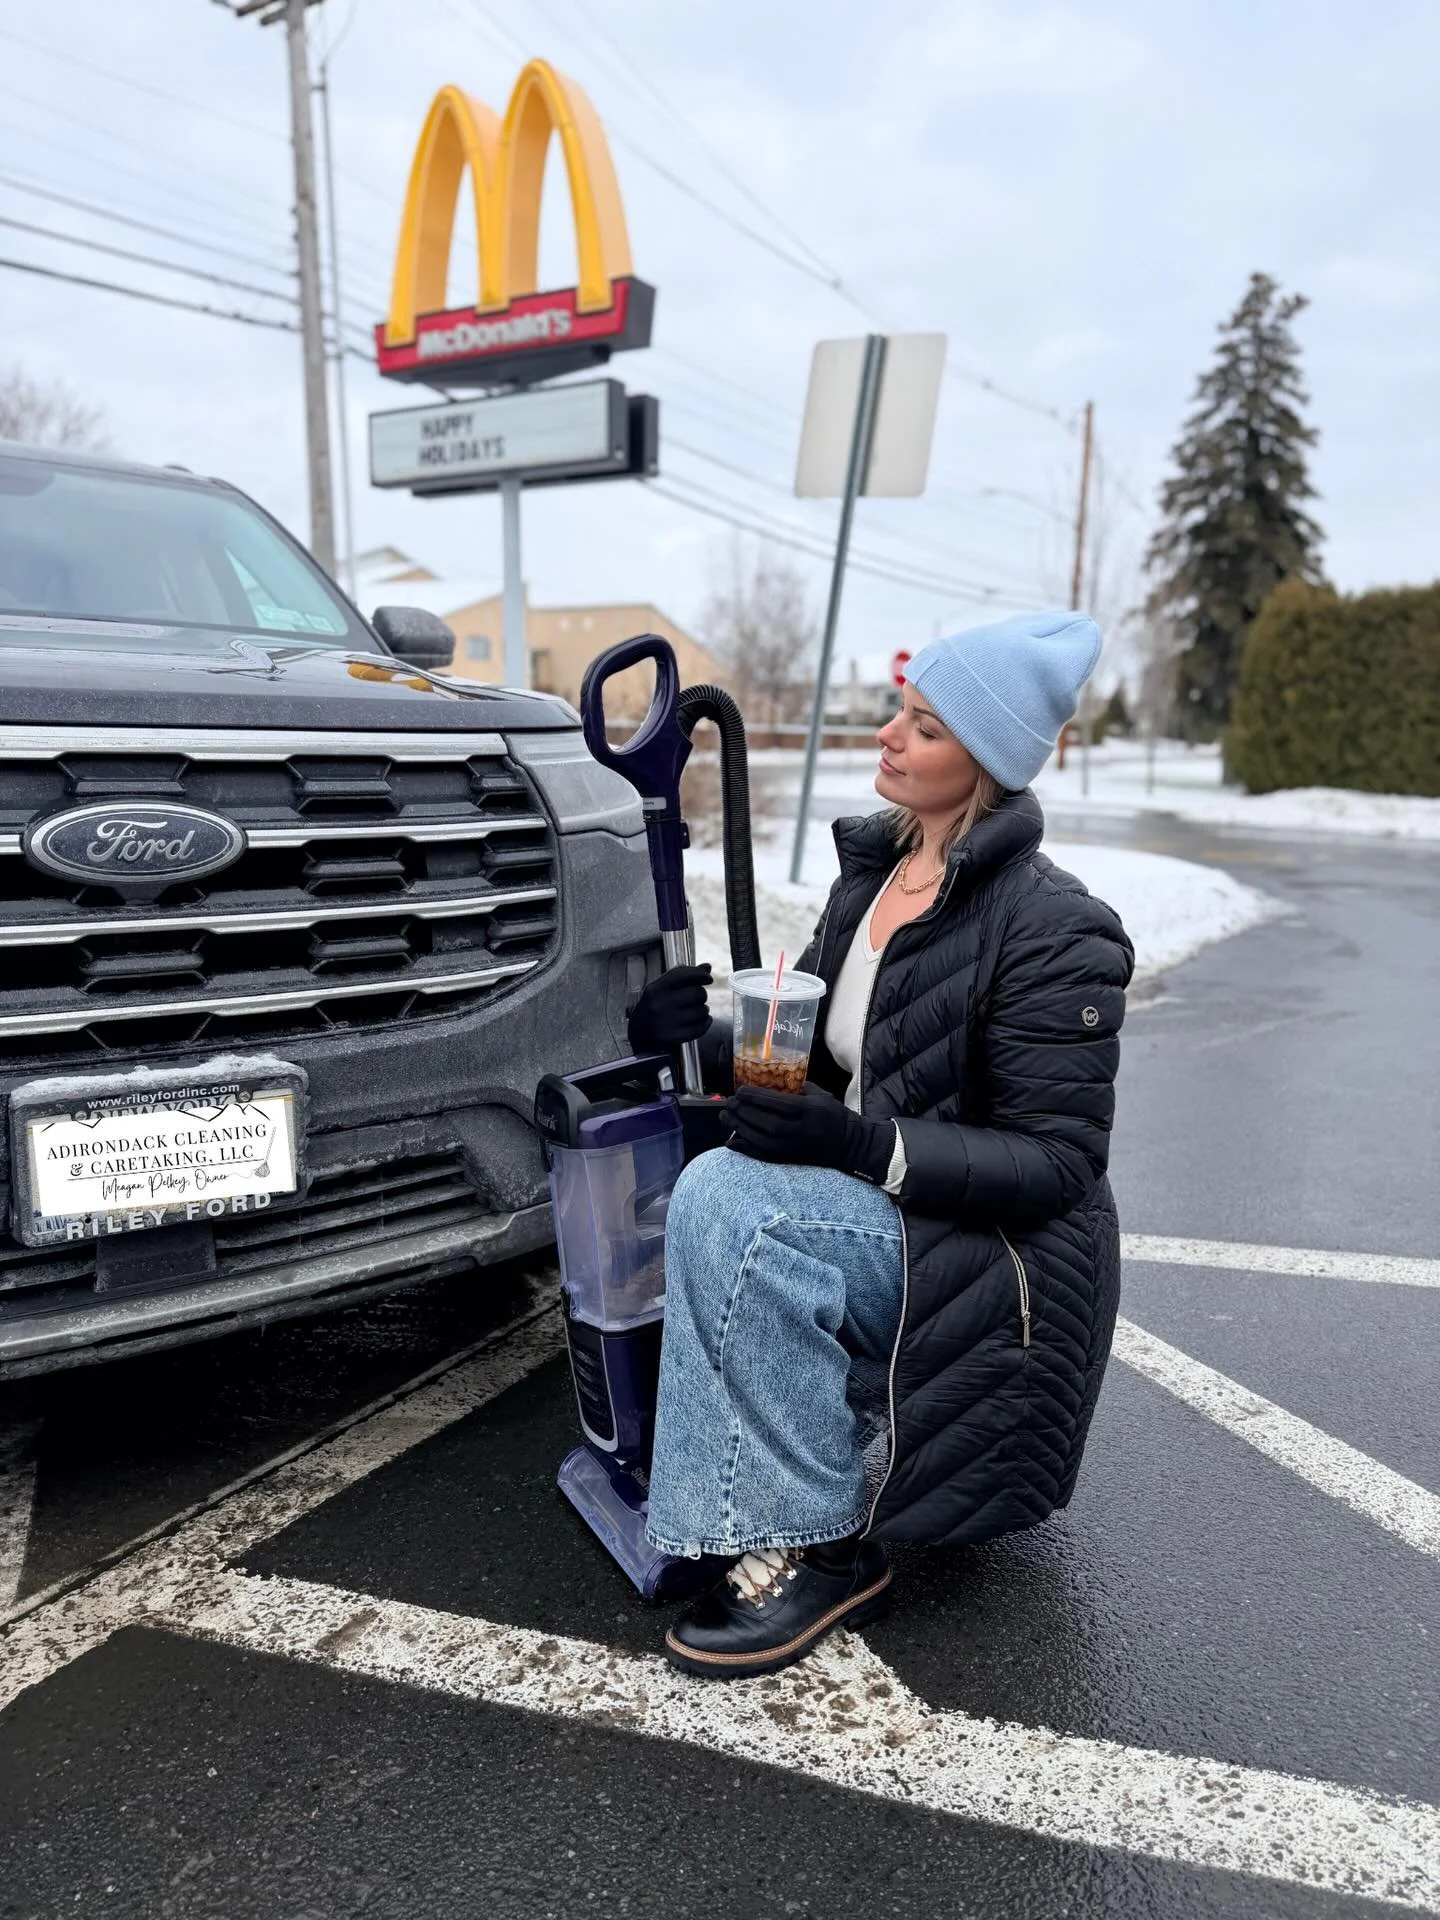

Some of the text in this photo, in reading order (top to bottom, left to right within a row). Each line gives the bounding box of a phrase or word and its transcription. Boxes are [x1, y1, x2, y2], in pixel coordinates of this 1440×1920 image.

[417, 309, 572, 358] McDonald's
[421, 412, 474, 440] HAPPY
[418, 434, 506, 466] HOLIDAYS
[86, 820, 195, 862] Ford
[86, 1084, 240, 1109] www.rileyfordinc.com
[66, 1193, 271, 1240] RILEY FORD
